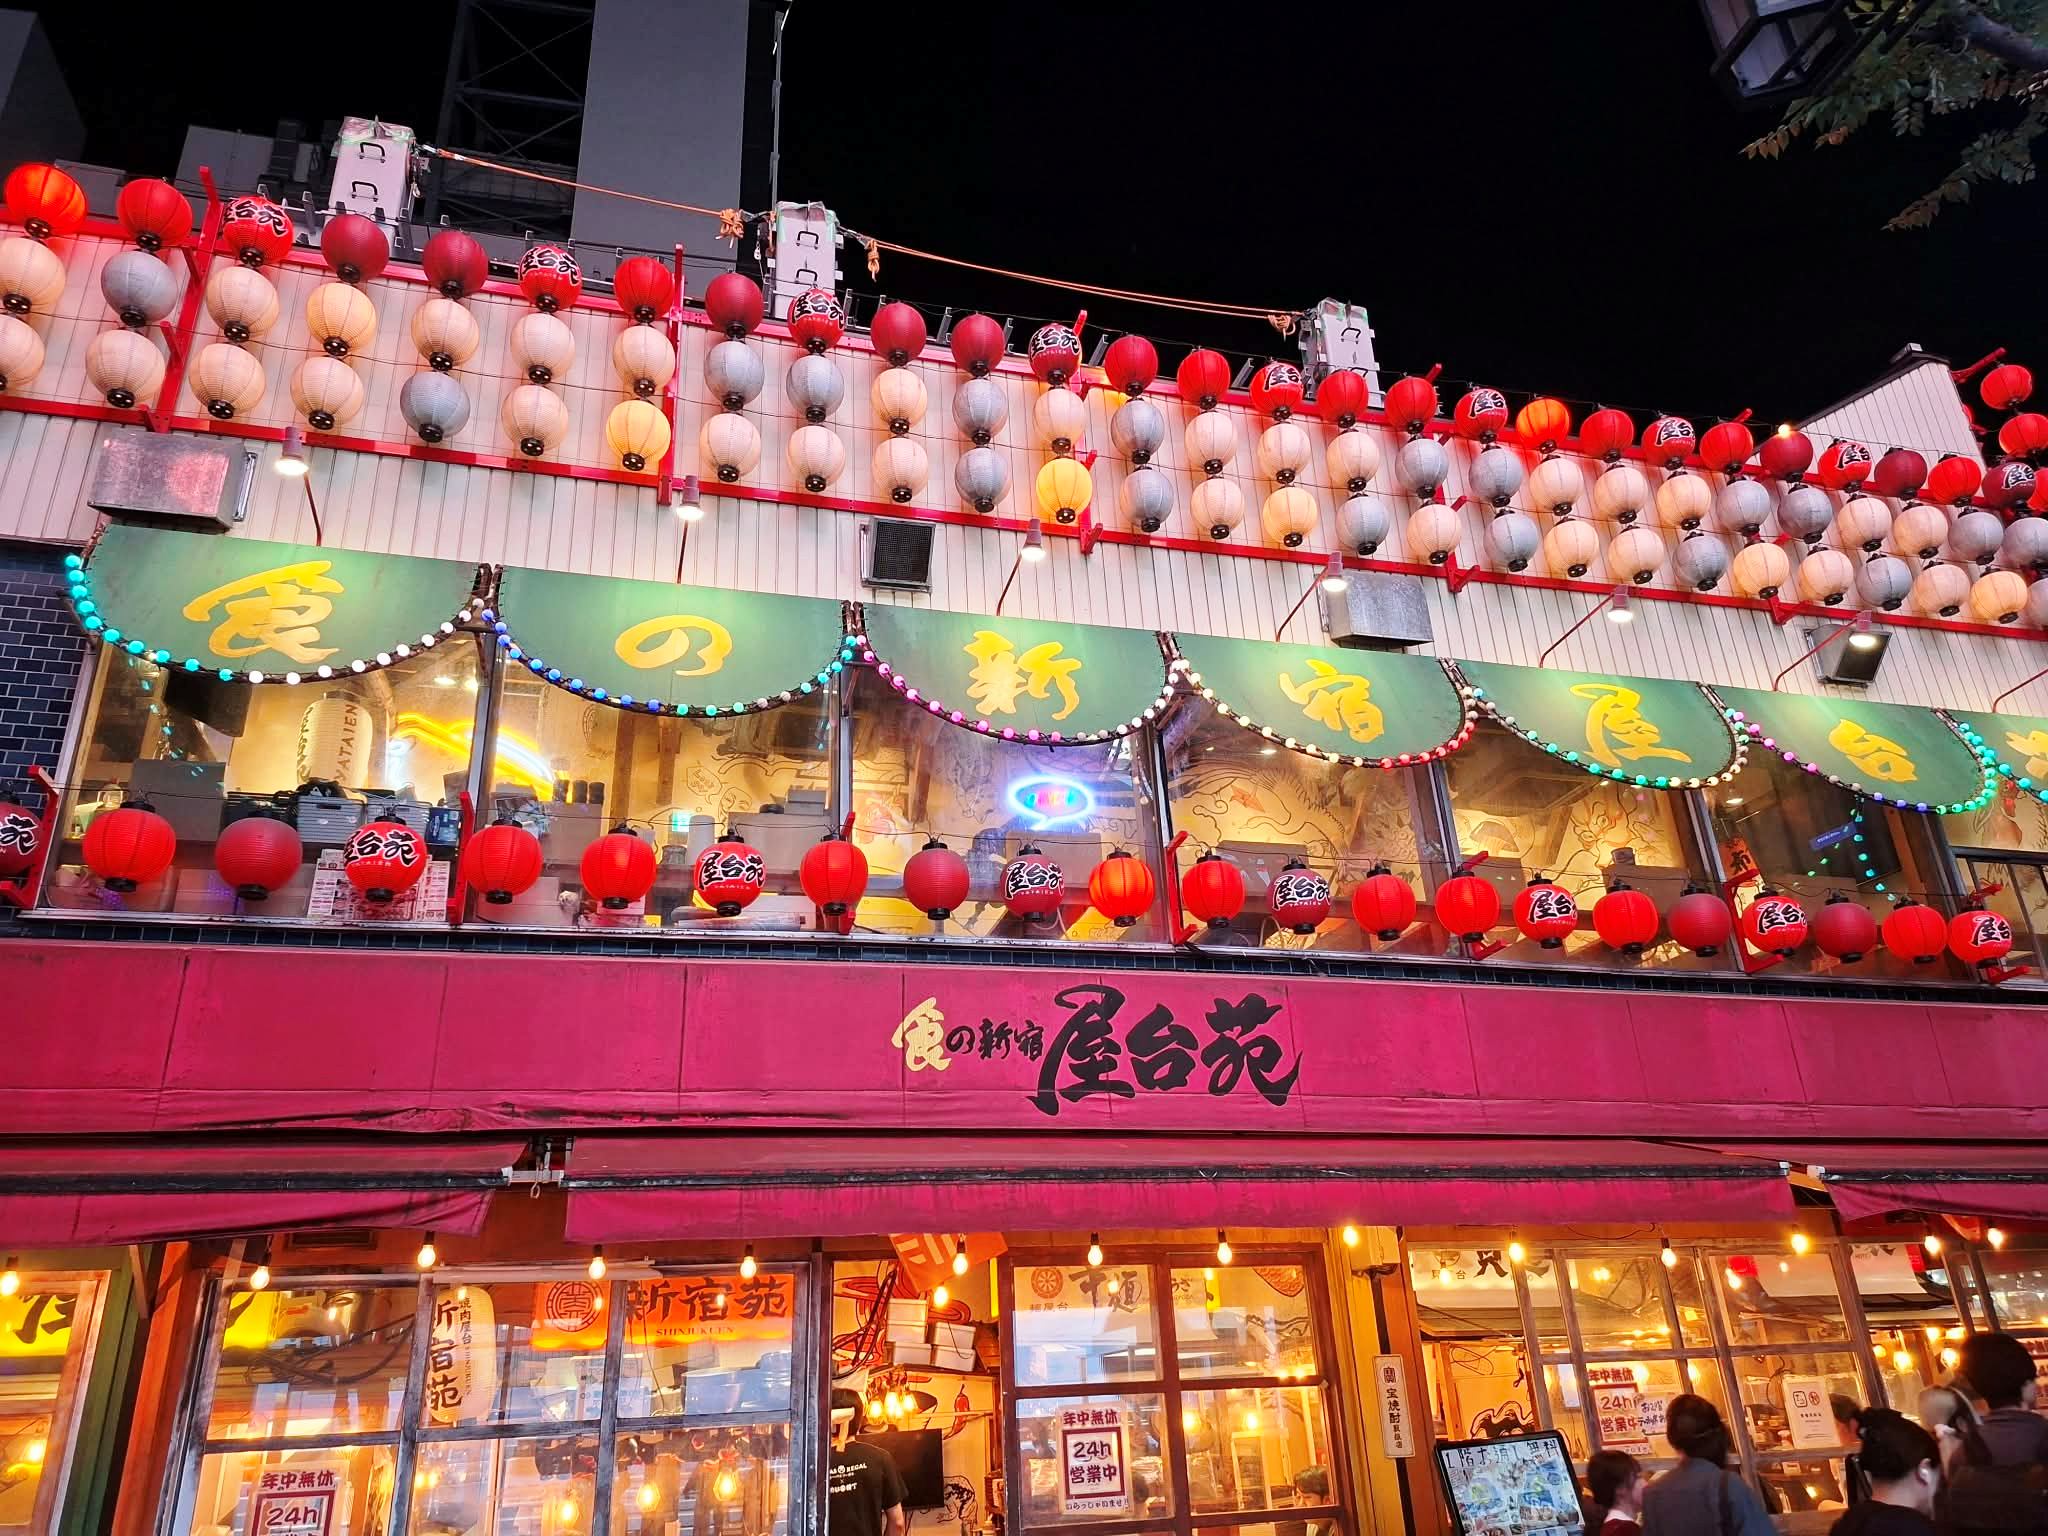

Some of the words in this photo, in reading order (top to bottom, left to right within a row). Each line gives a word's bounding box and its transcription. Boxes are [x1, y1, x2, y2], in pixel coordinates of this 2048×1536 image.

[182, 559, 345, 664] 食
[614, 613, 733, 677] の
[963, 629, 1082, 721] 新
[1279, 658, 1385, 743] 宿
[1568, 682, 1693, 768] 屋
[1828, 718, 1918, 784] 台
[625, 1277, 788, 1322] 新宿苑
[1063, 1409, 1118, 1426] 年中無休
[1070, 1464, 1117, 1484] 営業中
[1073, 1440, 1112, 1458] 24h
[261, 1469, 336, 1490] 年中無休
[266, 1506, 317, 1526] 24h
